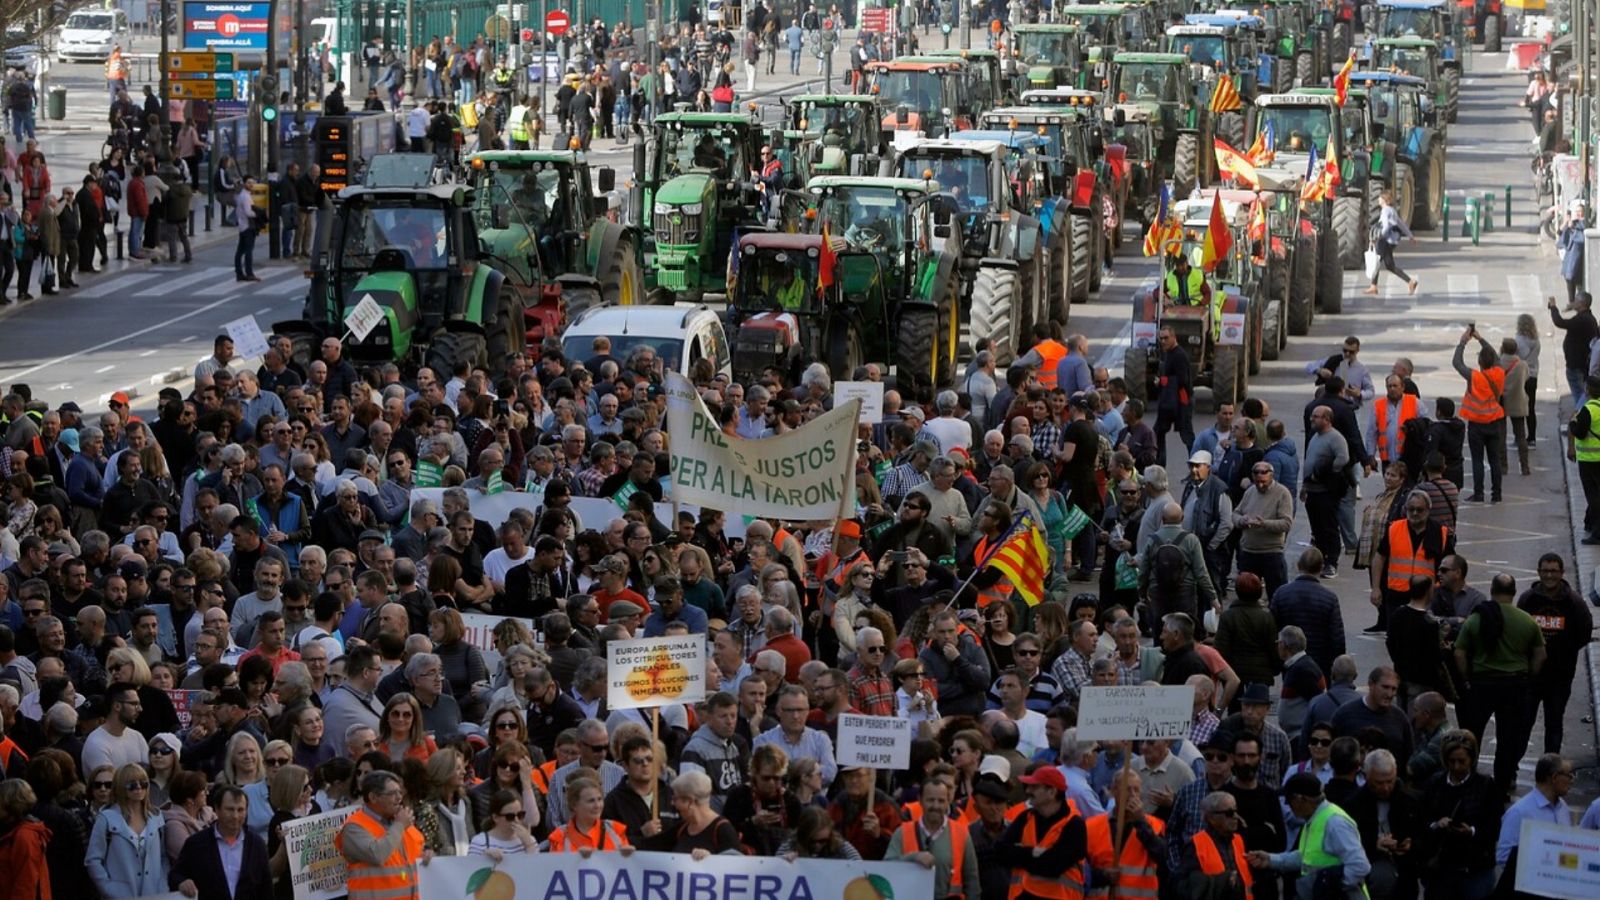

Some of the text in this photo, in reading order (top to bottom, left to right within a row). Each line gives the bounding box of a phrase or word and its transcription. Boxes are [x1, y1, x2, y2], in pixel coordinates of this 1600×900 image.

[753, 439, 836, 479] JUSTOS
[671, 456, 706, 490] PER
[710, 464, 725, 495] A
[729, 470, 756, 502] LA
[615, 647, 649, 655] EUROPA
[651, 643, 689, 652] ARRUINA
[615, 651, 697, 665] LOS CITRICULTORES
[633, 662, 681, 673] ESPAÑOLES
[613, 674, 700, 688] EXIGIMOS SOLUCIONES
[631, 685, 683, 696] INMEDIATAS
[1104, 687, 1147, 698] TARONJA
[844, 717, 864, 728] ESTEM
[892, 719, 907, 730] TANT
[1134, 719, 1191, 738] MATEU!
[291, 821, 316, 838] EUROPA
[291, 840, 305, 853] LOS
[544, 868, 815, 900] ADARIBERA
